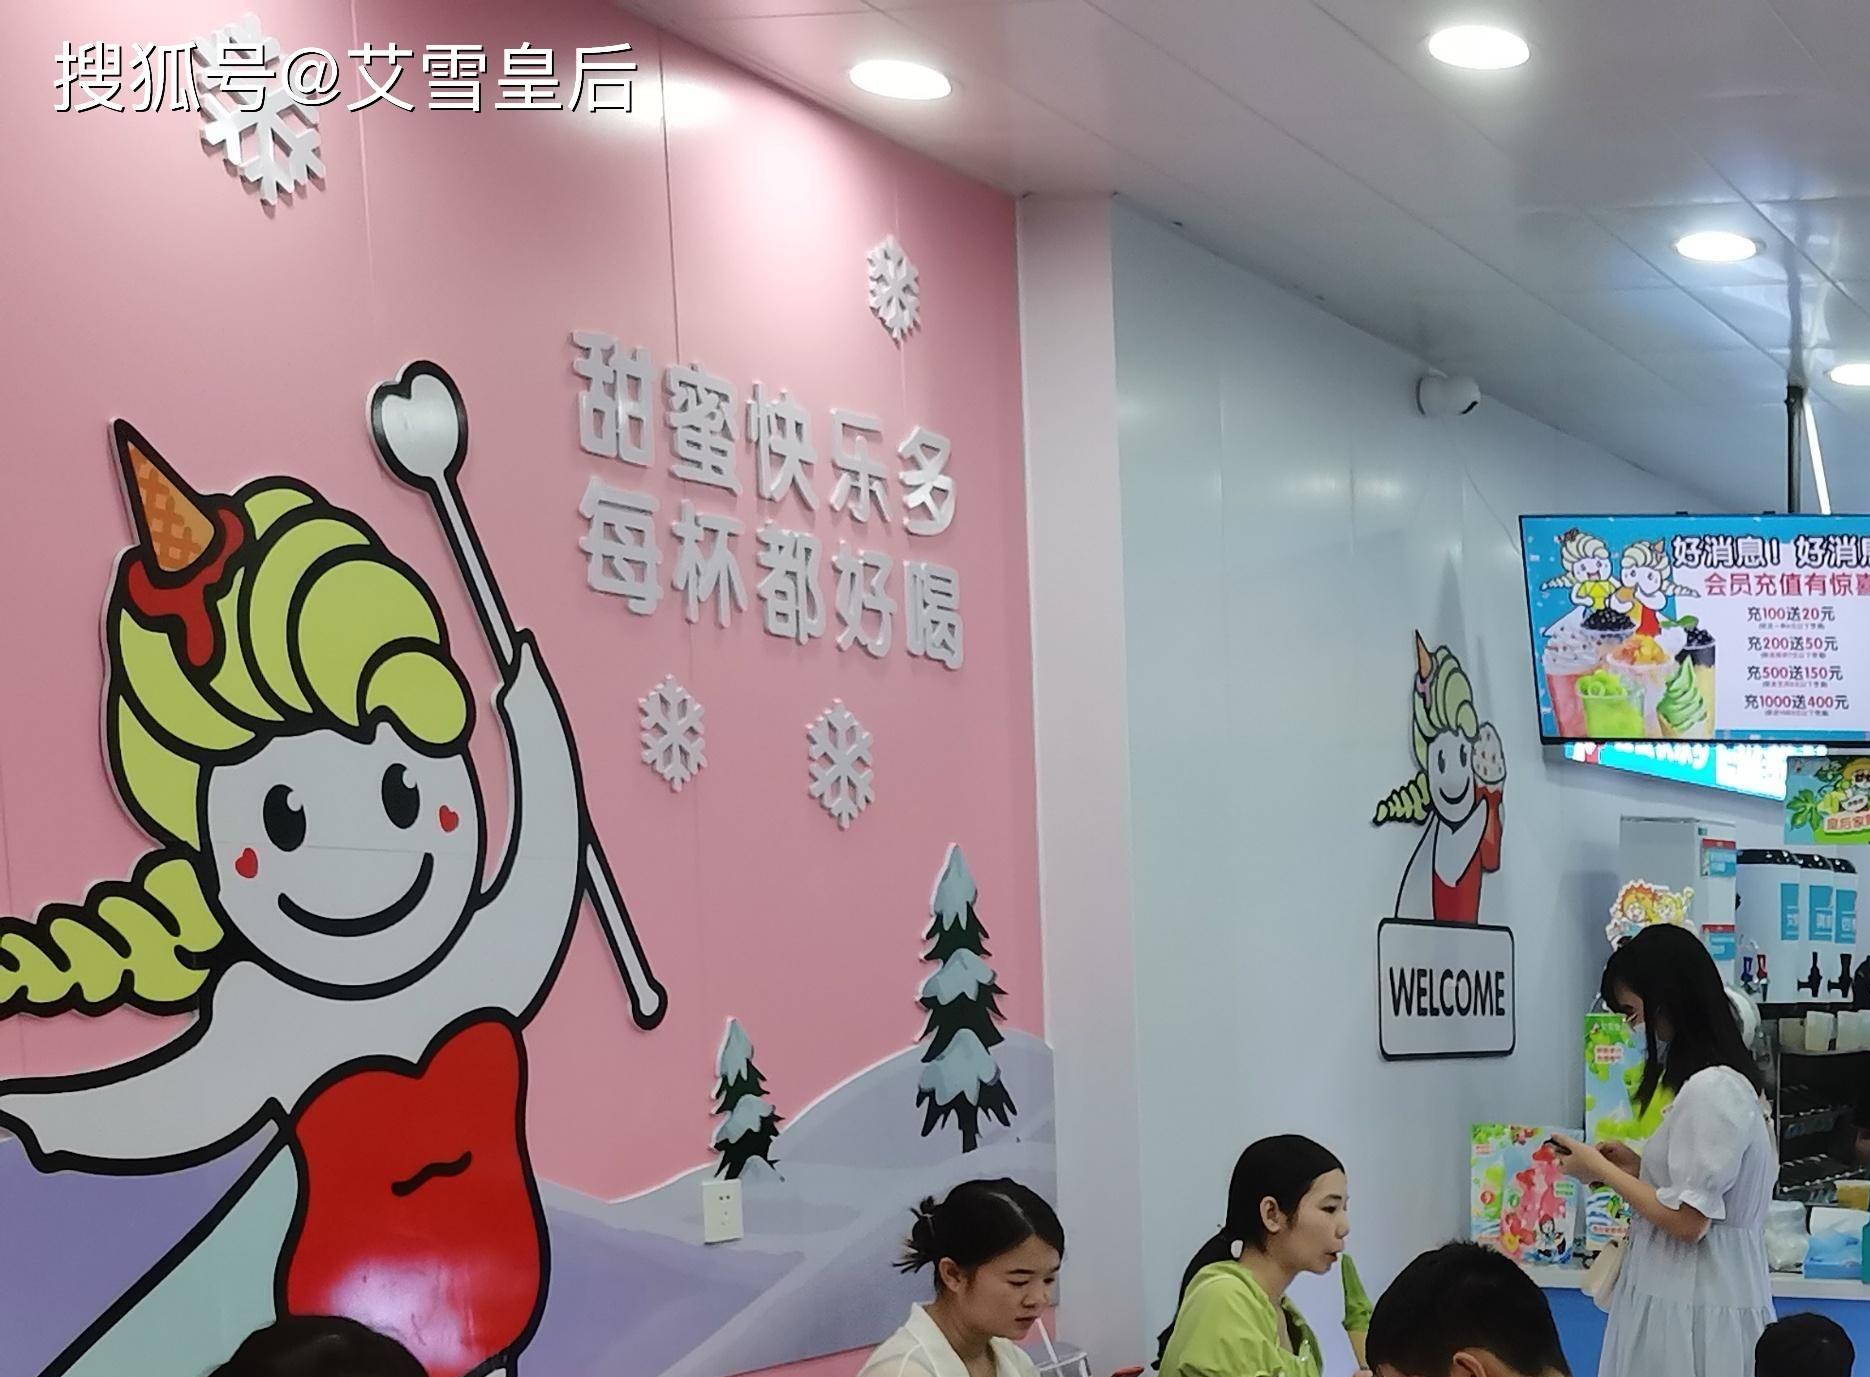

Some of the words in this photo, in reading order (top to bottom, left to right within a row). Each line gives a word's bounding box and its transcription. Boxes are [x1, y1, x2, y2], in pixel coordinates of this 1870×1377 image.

[571, 330, 957, 536] 甜蜜快乐多
[578, 475, 964, 670] 每杯都好喝
[1747, 606, 1836, 622] 充100送20元
[1747, 636, 1839, 652] 充200送50元
[1747, 665, 1843, 681] 充500送150元
[1744, 694, 1850, 710] 充1000送400元
[1389, 965, 1506, 1018] WELCOME
